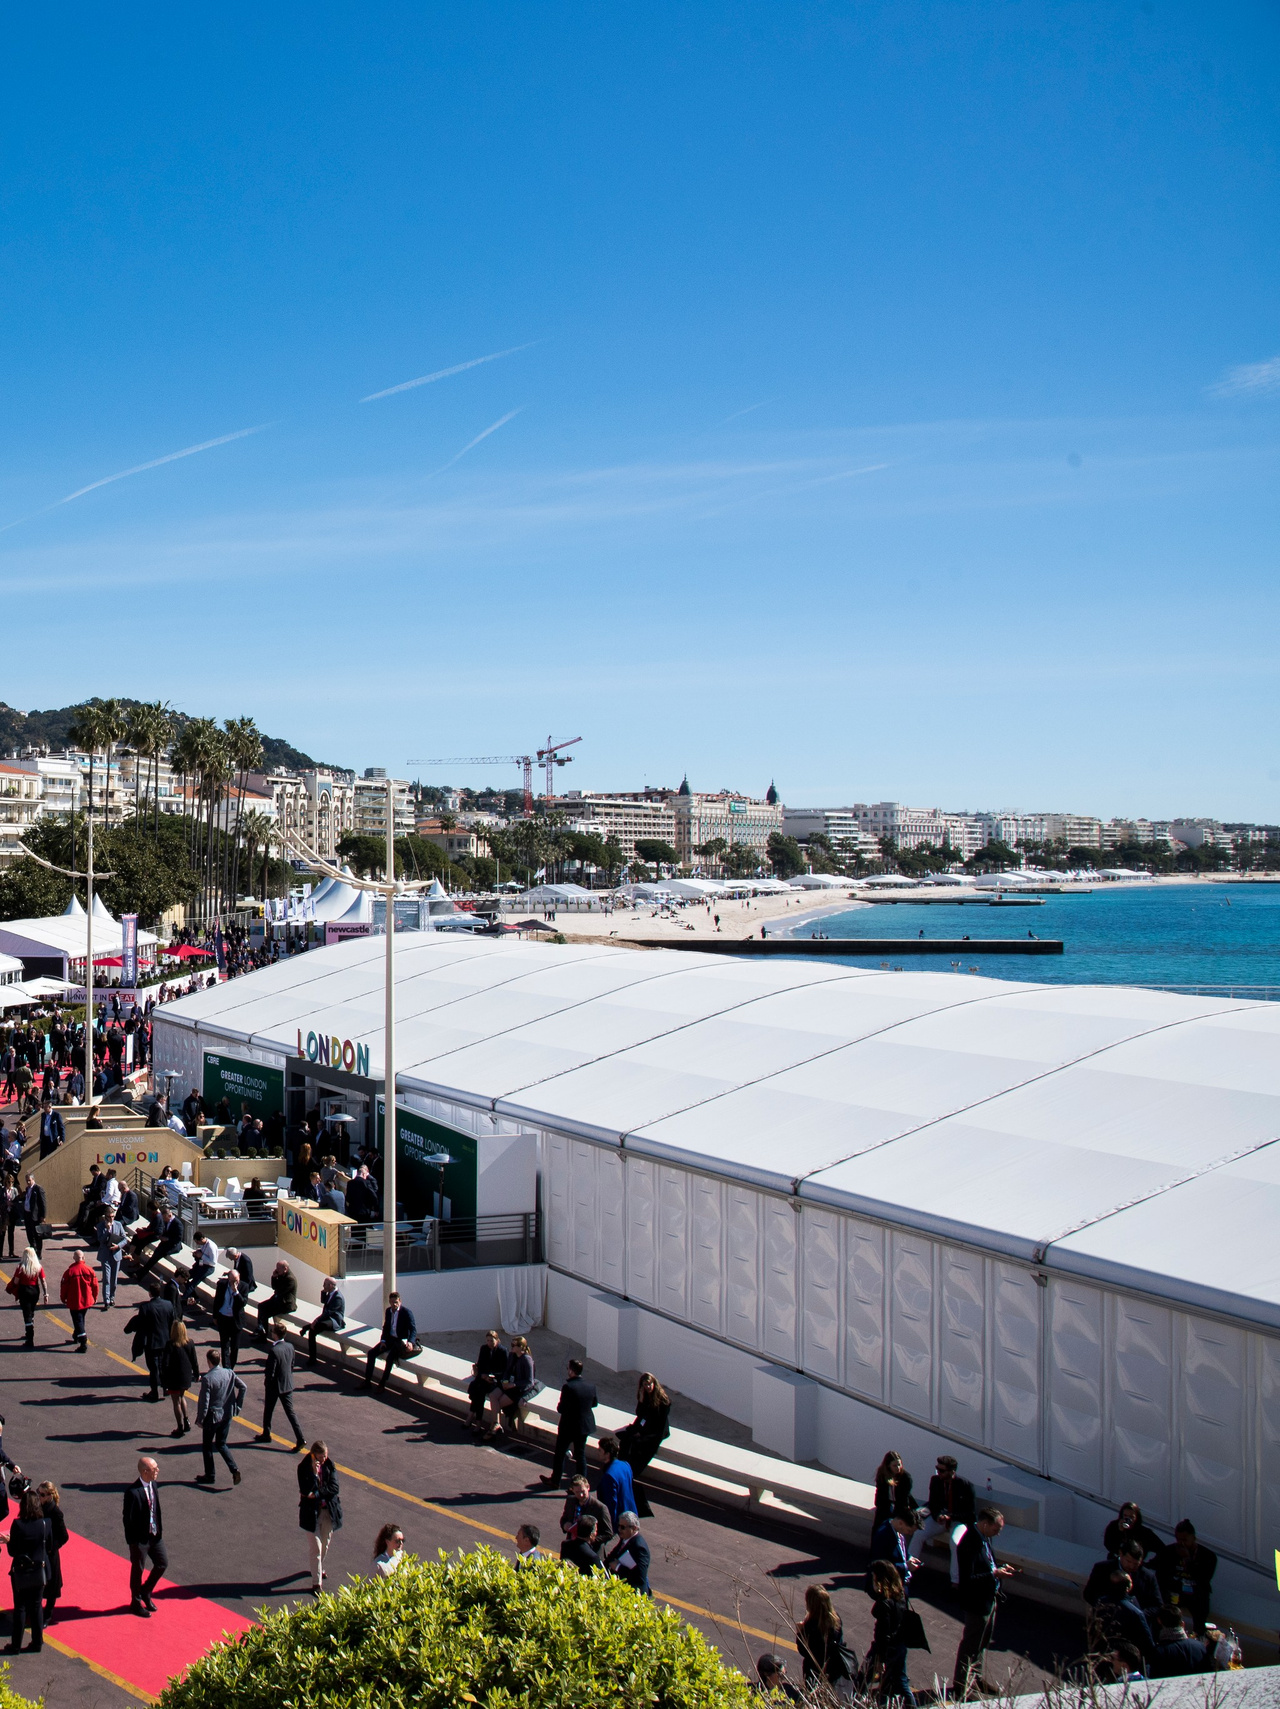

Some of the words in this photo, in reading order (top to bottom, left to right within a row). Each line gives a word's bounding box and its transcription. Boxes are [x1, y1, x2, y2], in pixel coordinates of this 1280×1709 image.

[328, 925, 370, 933] newcastle
[109, 994, 134, 1002] GEAT
[207, 1055, 220, 1066] CBRE
[297, 1028, 369, 1078] LONDON
[220, 1069, 244, 1084] GREATER
[244, 1078, 268, 1090] LONDON
[224, 1082, 263, 1101] OPPORTUNITIES
[400, 1127, 424, 1148] GREATER
[96, 1151, 158, 1165] LONDON
[281, 1206, 327, 1248] LONDON
